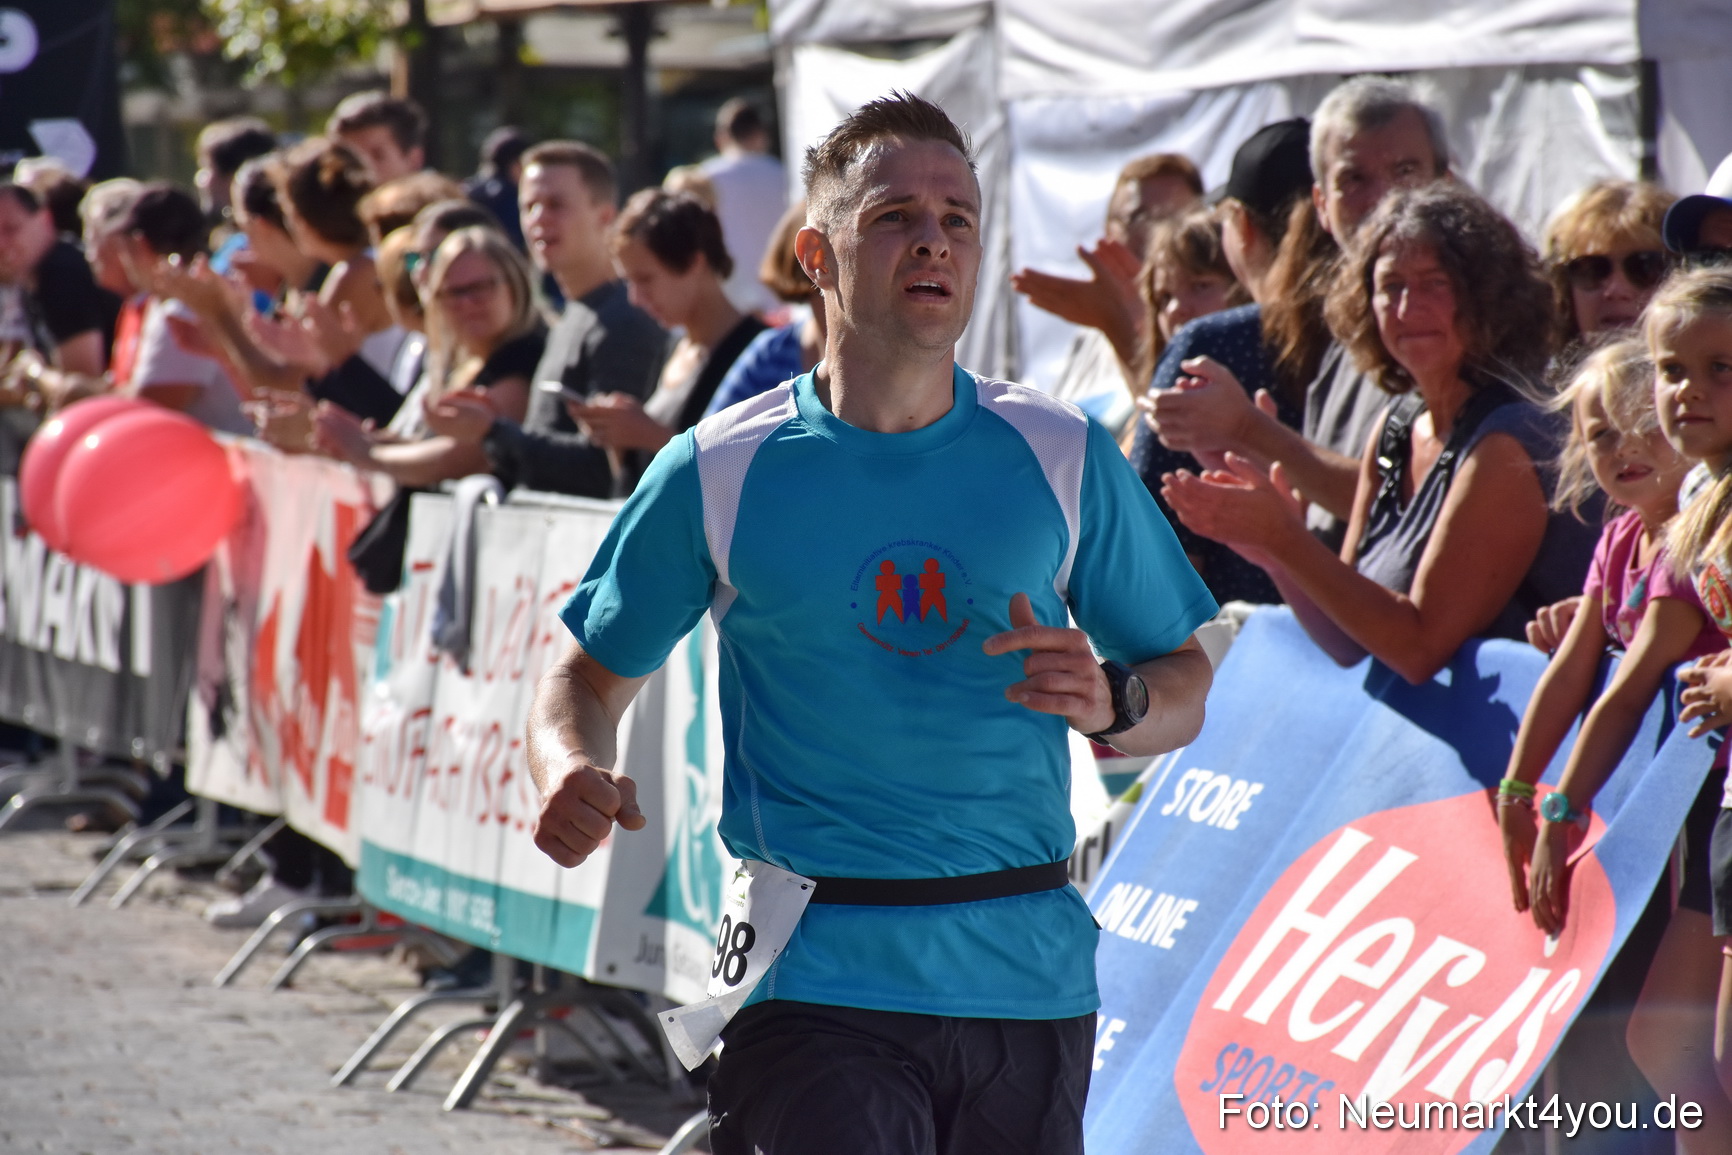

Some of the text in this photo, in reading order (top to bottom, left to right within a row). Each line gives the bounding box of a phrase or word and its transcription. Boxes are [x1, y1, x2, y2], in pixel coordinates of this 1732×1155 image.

[888, 539, 942, 552] krebskranker
[942, 548, 964, 571] Kinder
[1161, 767, 1264, 831] STORE
[712, 913, 756, 987] 98
[1096, 882, 1199, 950] ONLINE
[1212, 827, 1581, 1124] Hervis
[1199, 1042, 1335, 1123] SPORTS
